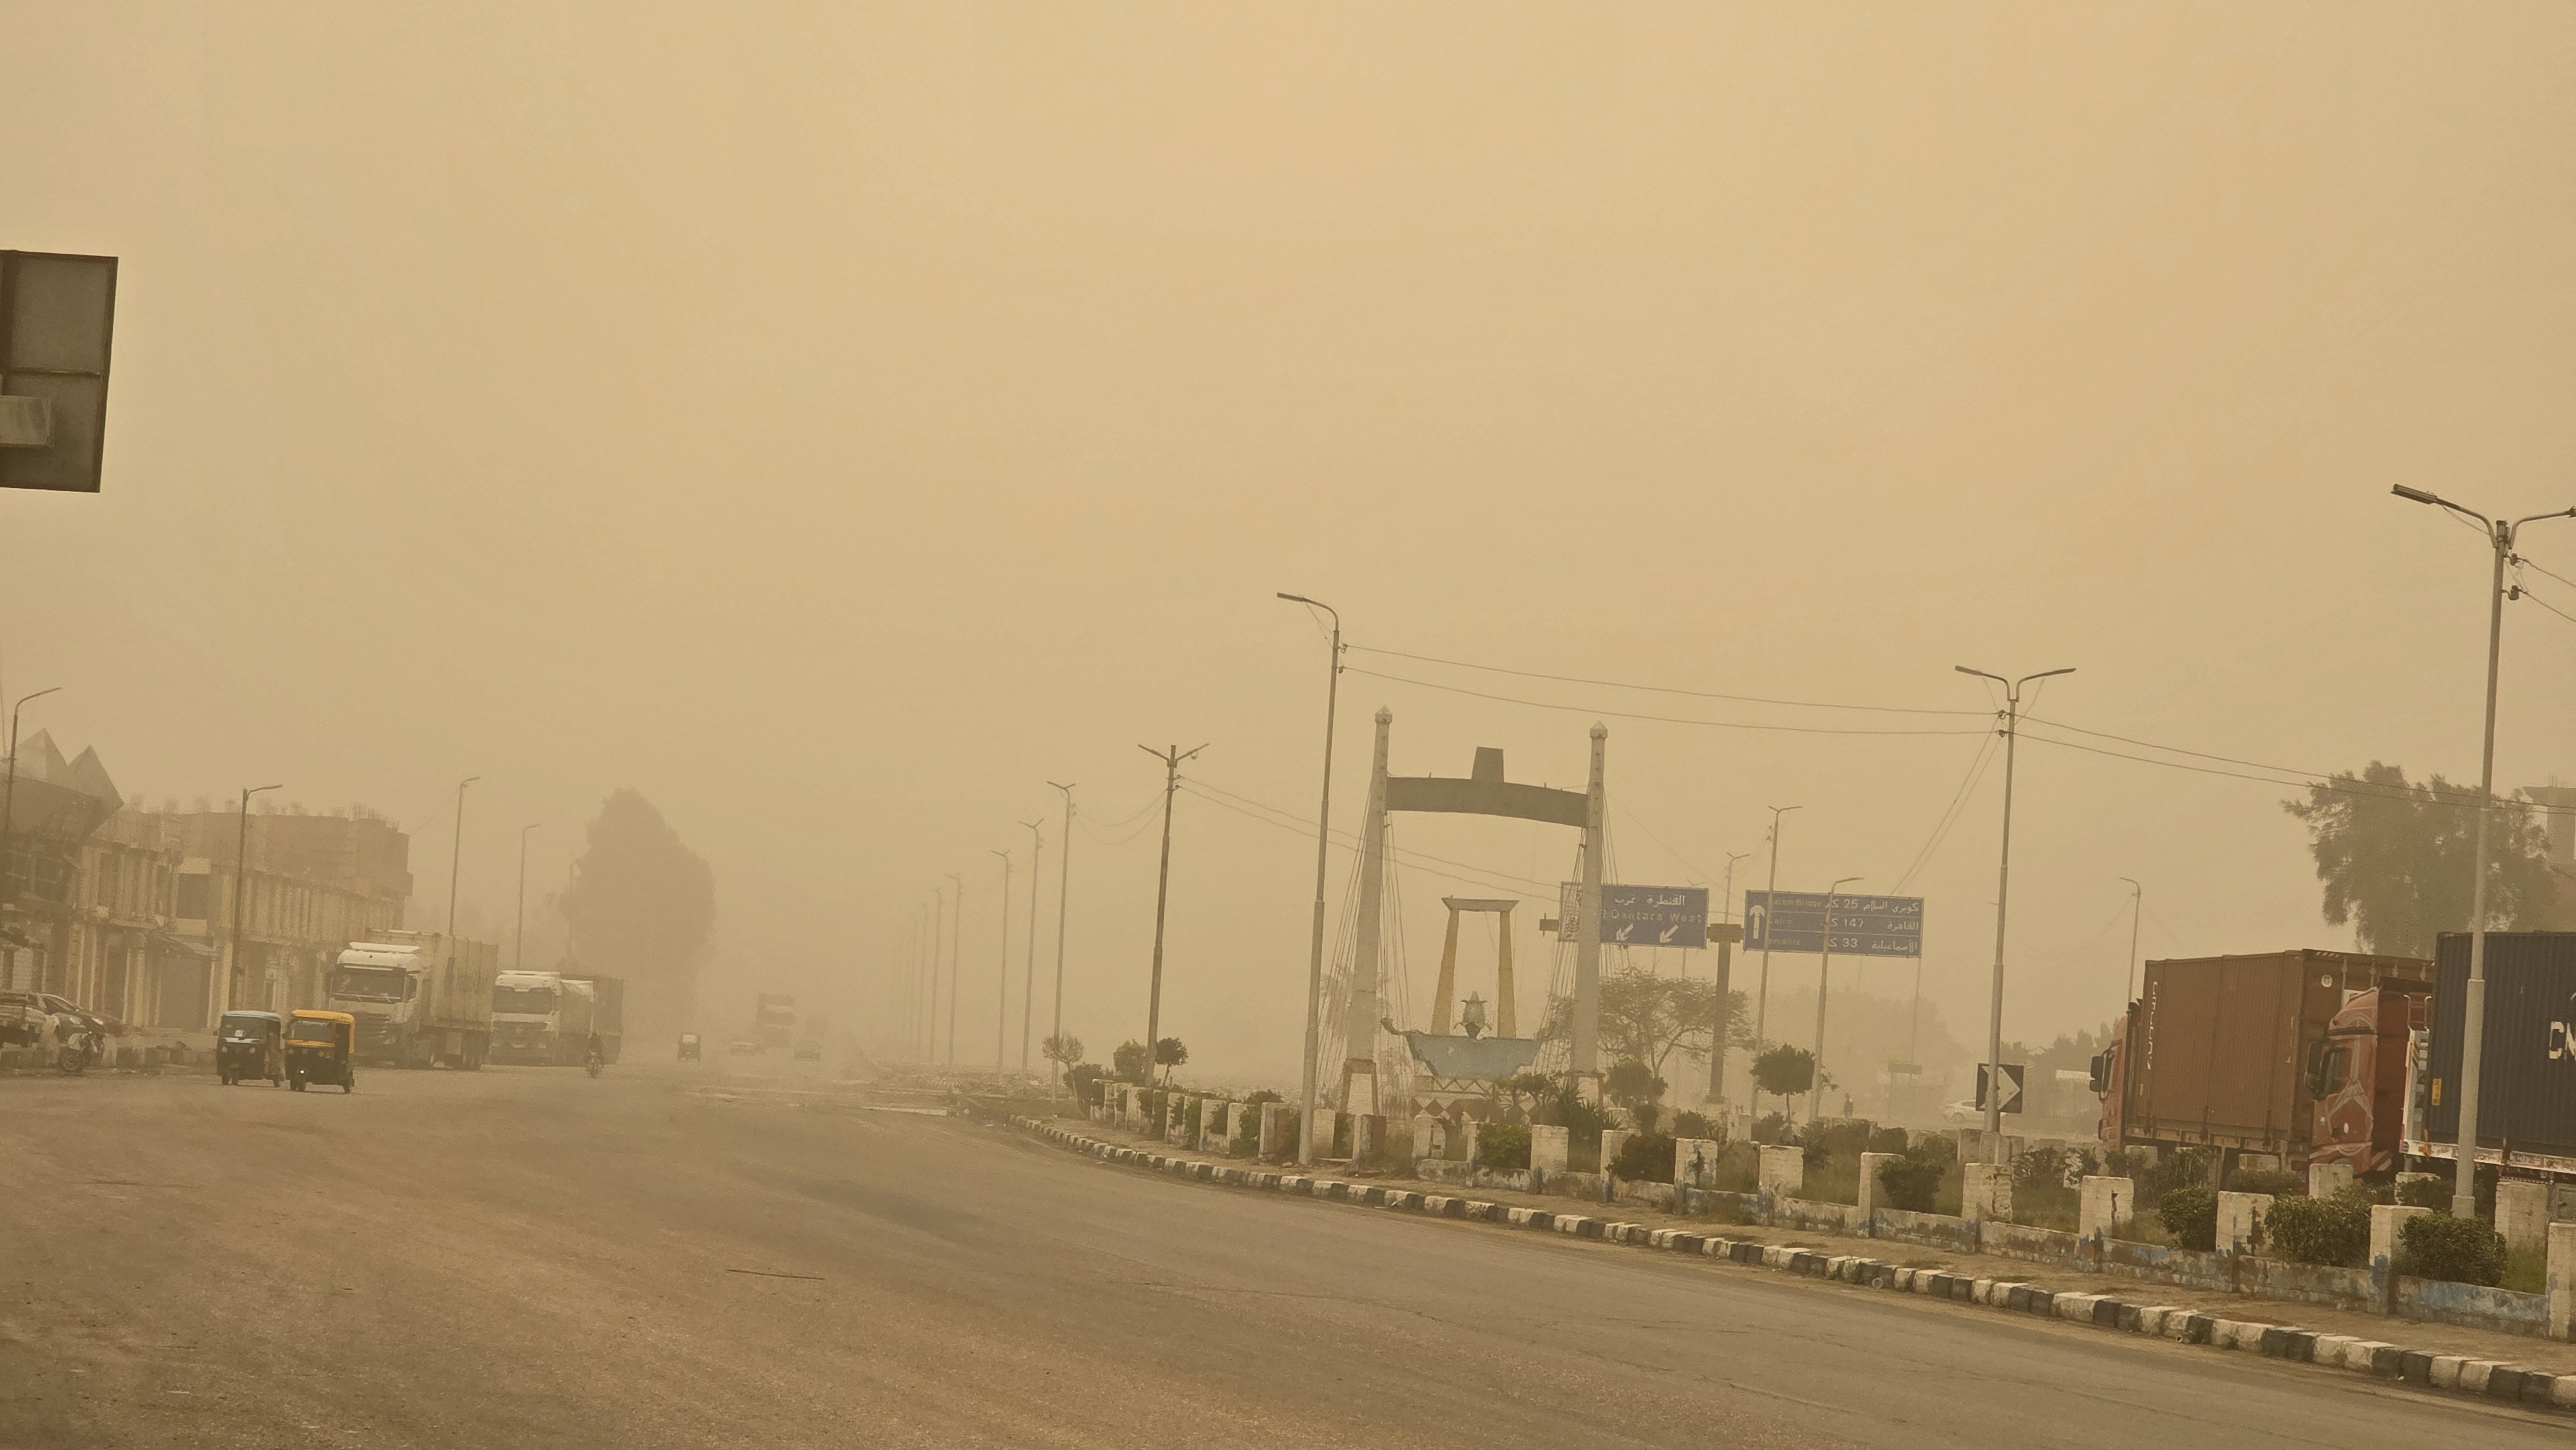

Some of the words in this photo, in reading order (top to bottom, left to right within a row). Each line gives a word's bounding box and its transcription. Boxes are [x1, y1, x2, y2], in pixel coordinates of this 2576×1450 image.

[1614, 894, 1636, 907] غرب
[1646, 894, 1685, 908] القنطرة
[1795, 898, 1823, 908] Bridge
[1843, 898, 1859, 910] 25
[1863, 899, 1888, 912] السلام
[1670, 912, 1702, 923] West
[1844, 918, 1864, 928] 147
[1887, 920, 1919, 932] القاهرة
[1768, 937, 1801, 946] smailia
[1842, 937, 1858, 948] 33
